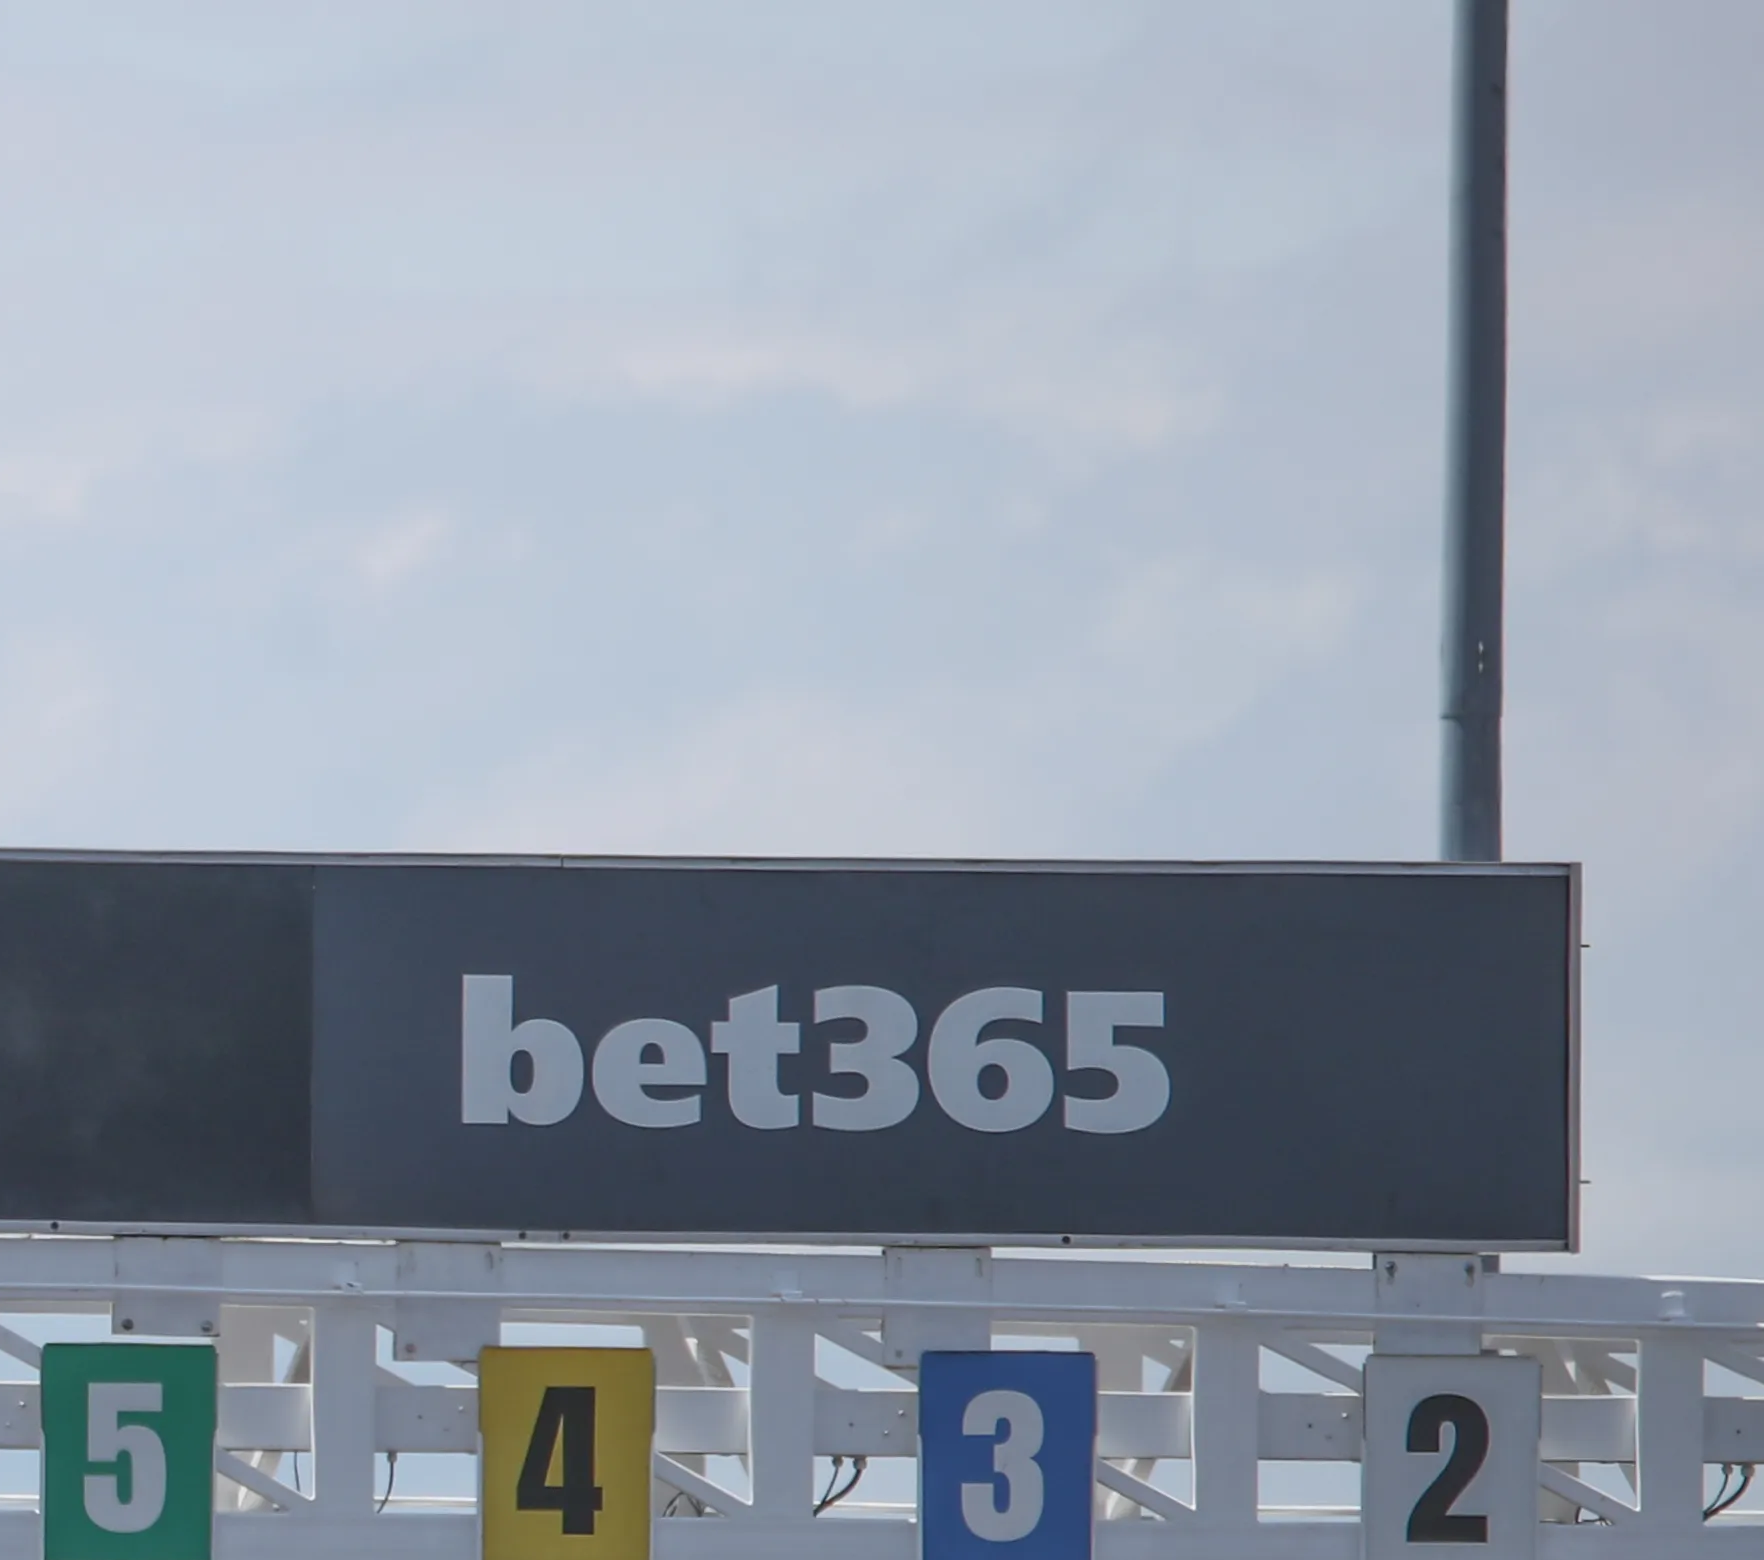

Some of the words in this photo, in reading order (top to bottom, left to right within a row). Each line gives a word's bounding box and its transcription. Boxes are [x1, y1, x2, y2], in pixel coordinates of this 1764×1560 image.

[462, 974, 1171, 1133] bet365
[82, 1382, 167, 1534] 5
[514, 1385, 604, 1536] 4
[961, 1391, 1045, 1543] 3
[1404, 1392, 1490, 1544] 2
